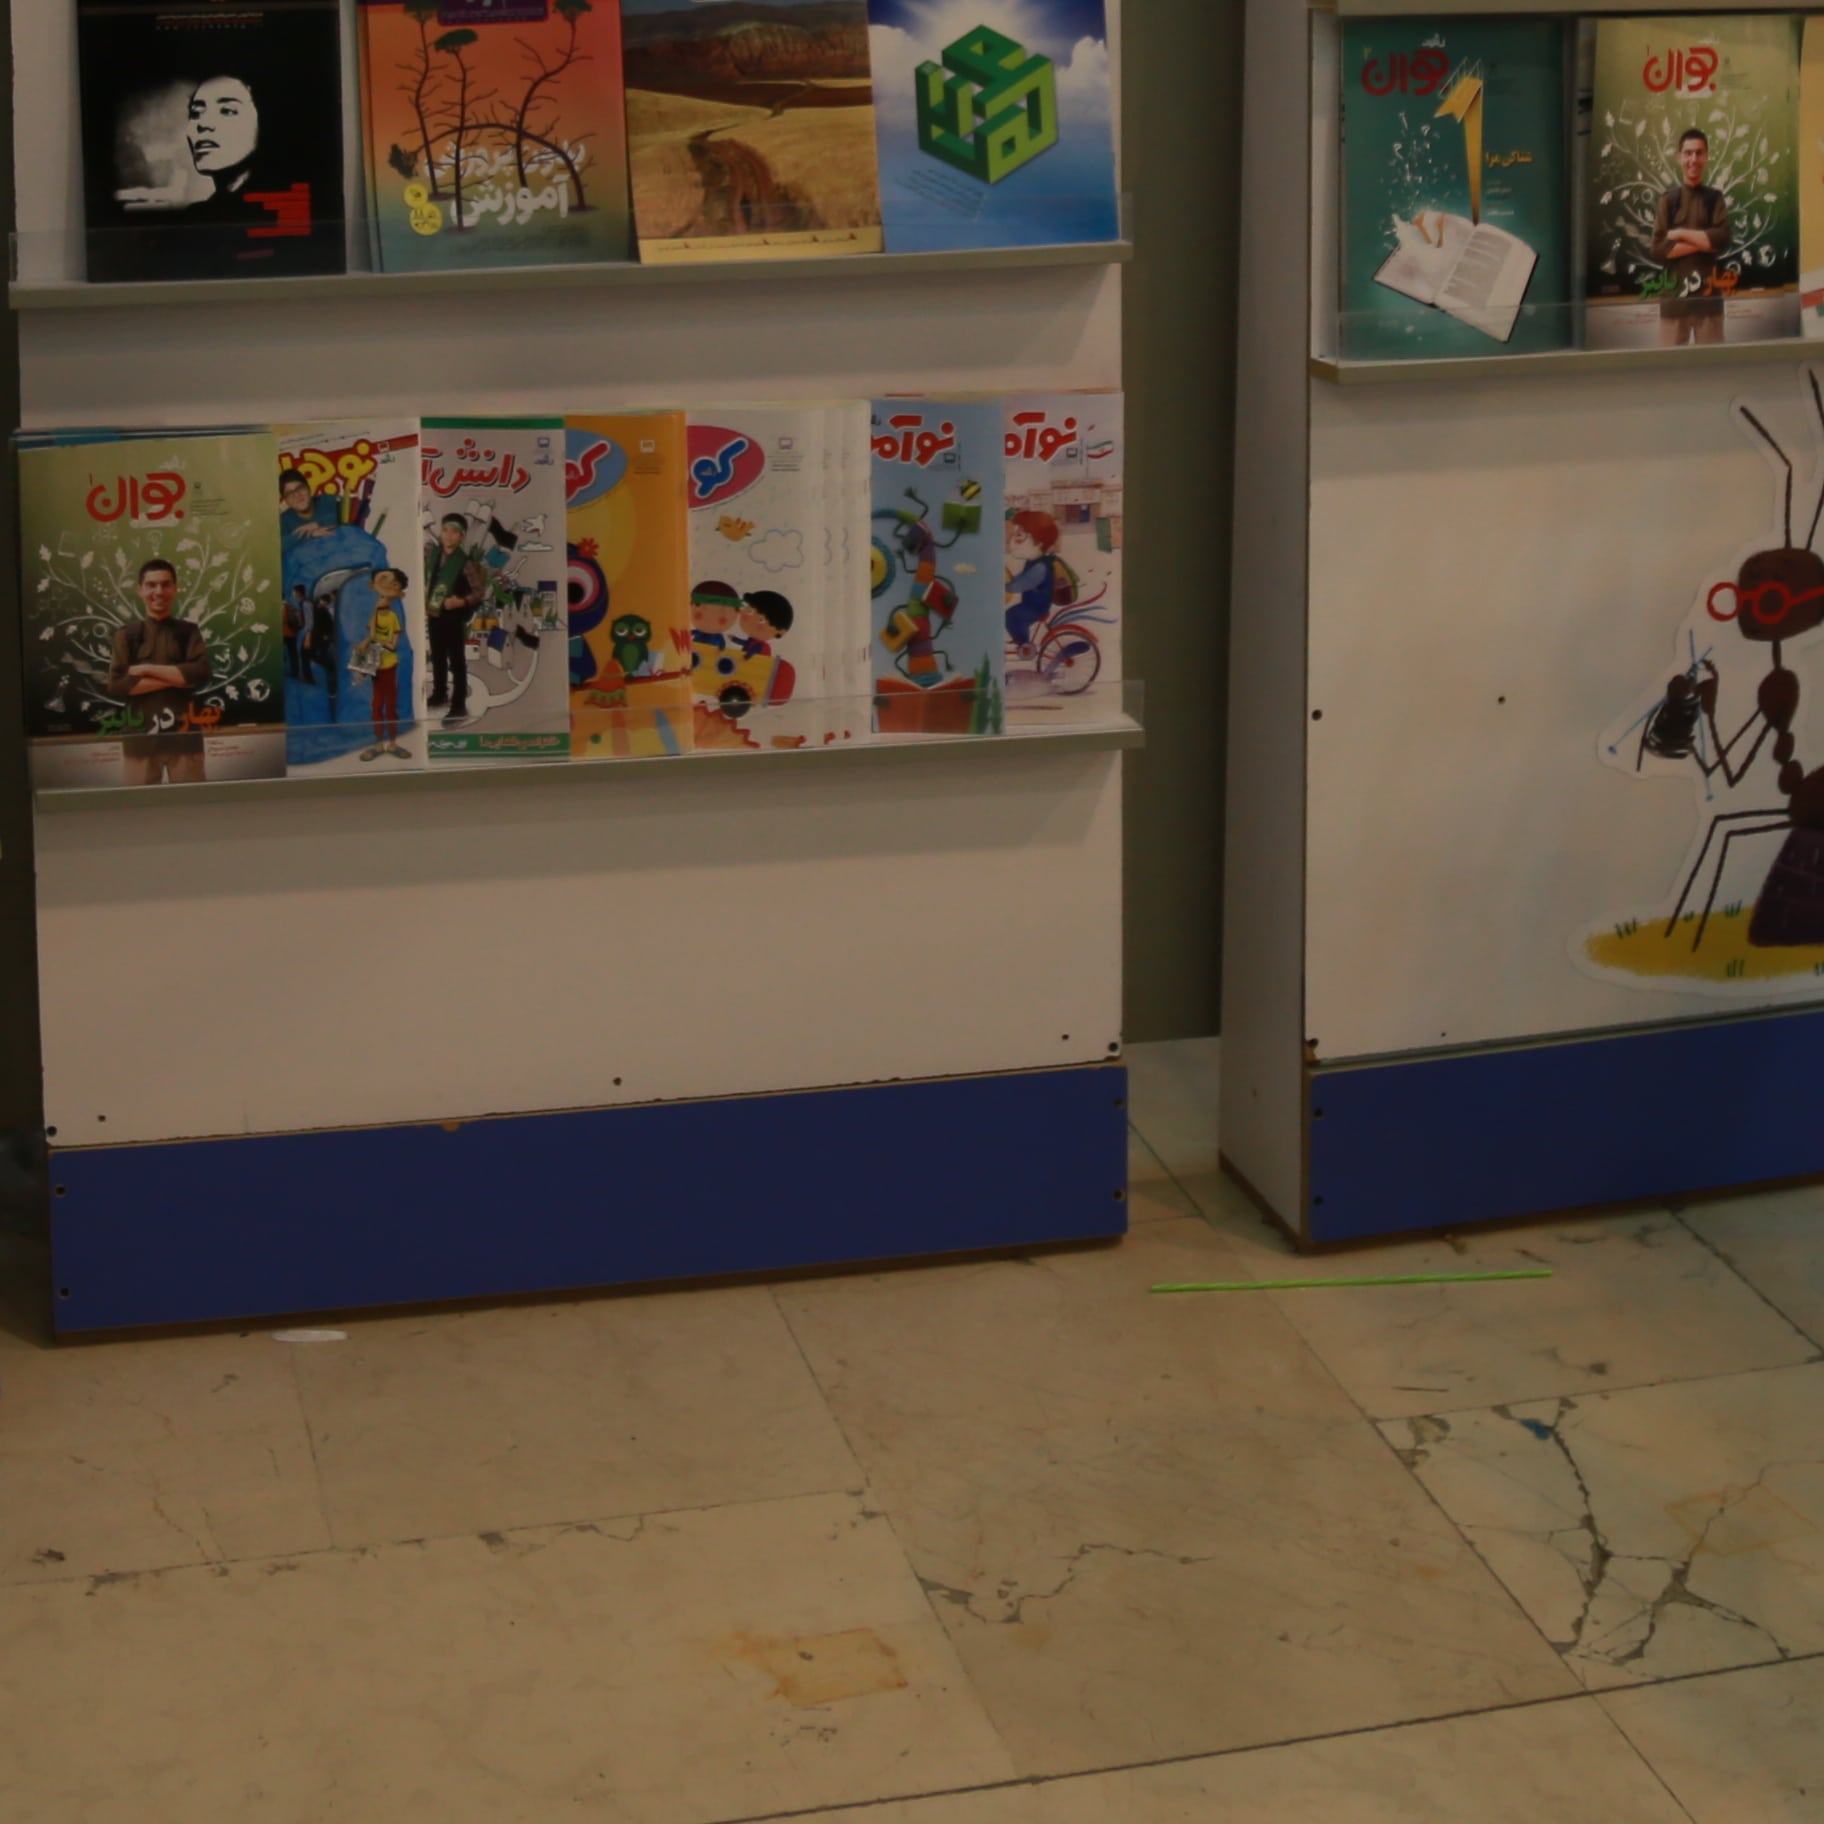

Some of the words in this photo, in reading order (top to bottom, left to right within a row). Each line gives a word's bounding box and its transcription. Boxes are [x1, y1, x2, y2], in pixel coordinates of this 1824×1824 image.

[1643, 47, 1719, 93] جوان
[449, 172, 570, 228] آموزش
[1679, 271, 1701, 297] در
[430, 437, 532, 497] دانش
[86, 472, 186, 522] جوان
[147, 707, 175, 735] در
